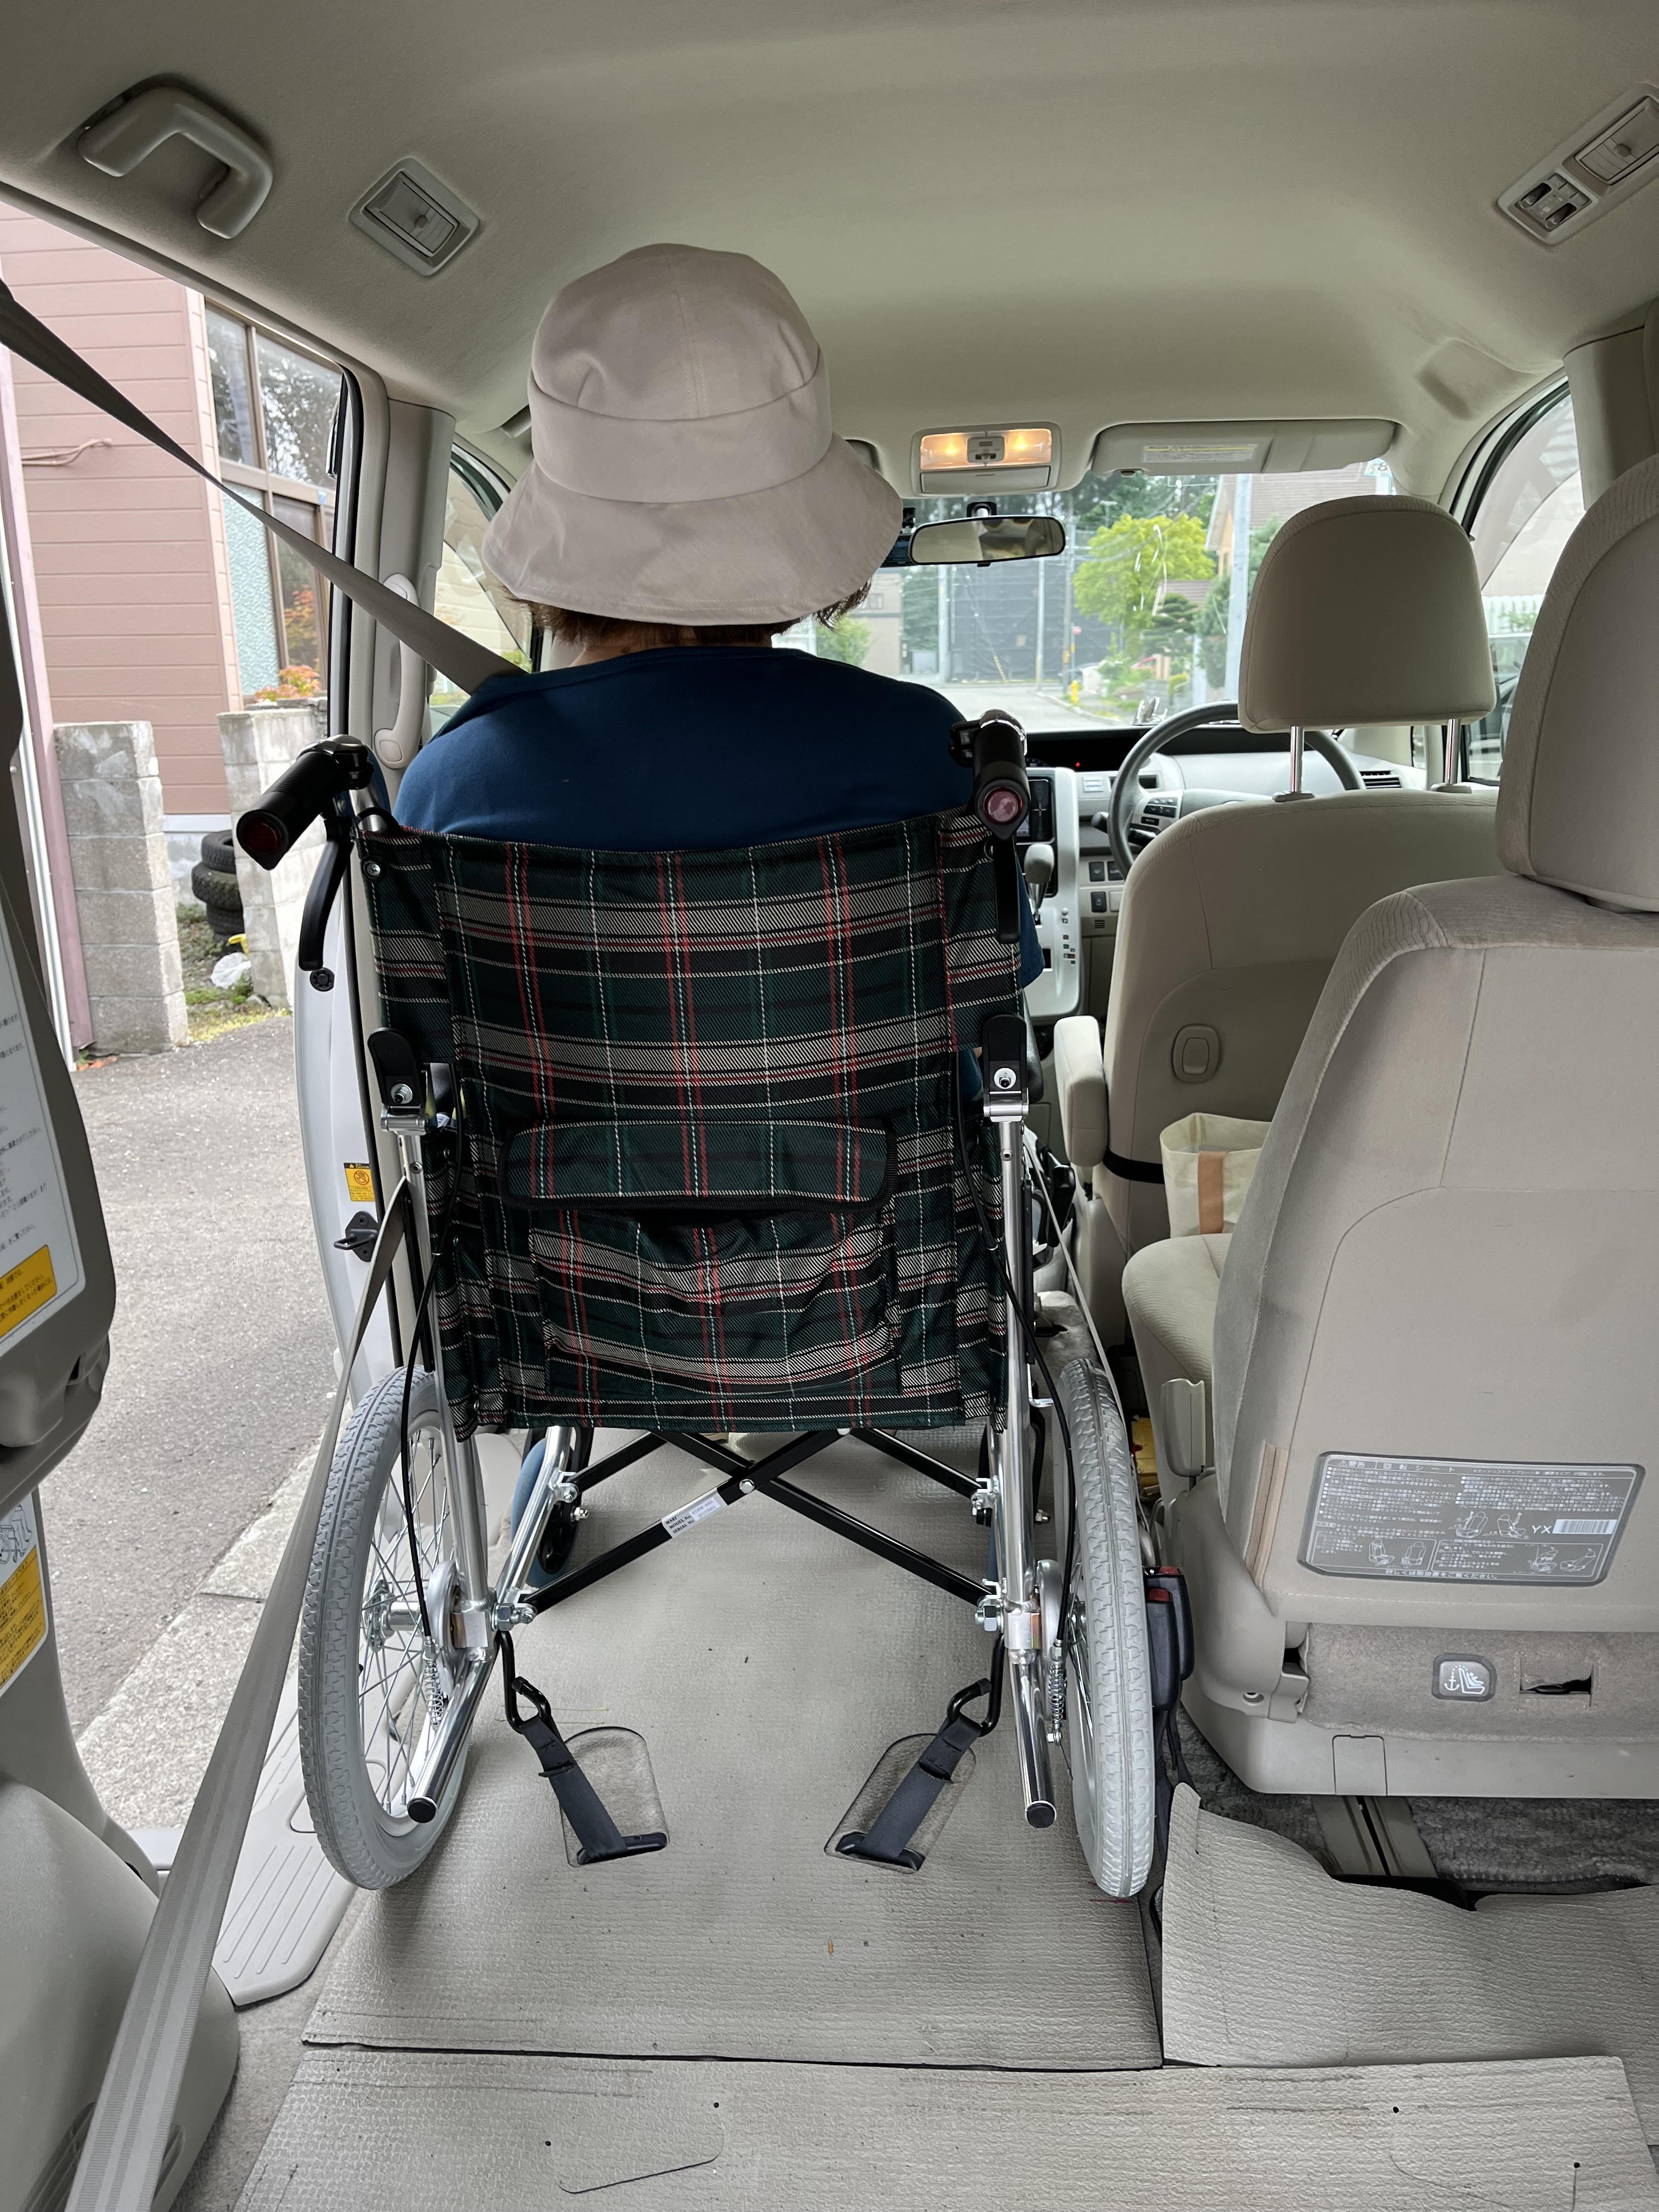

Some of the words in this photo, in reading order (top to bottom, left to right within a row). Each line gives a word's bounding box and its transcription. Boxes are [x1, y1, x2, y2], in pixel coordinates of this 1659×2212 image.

[669, 1519, 685, 1530] MODEL
[673, 1523, 689, 1534] SERIAL
[1531, 1525, 1553, 1534] YX
